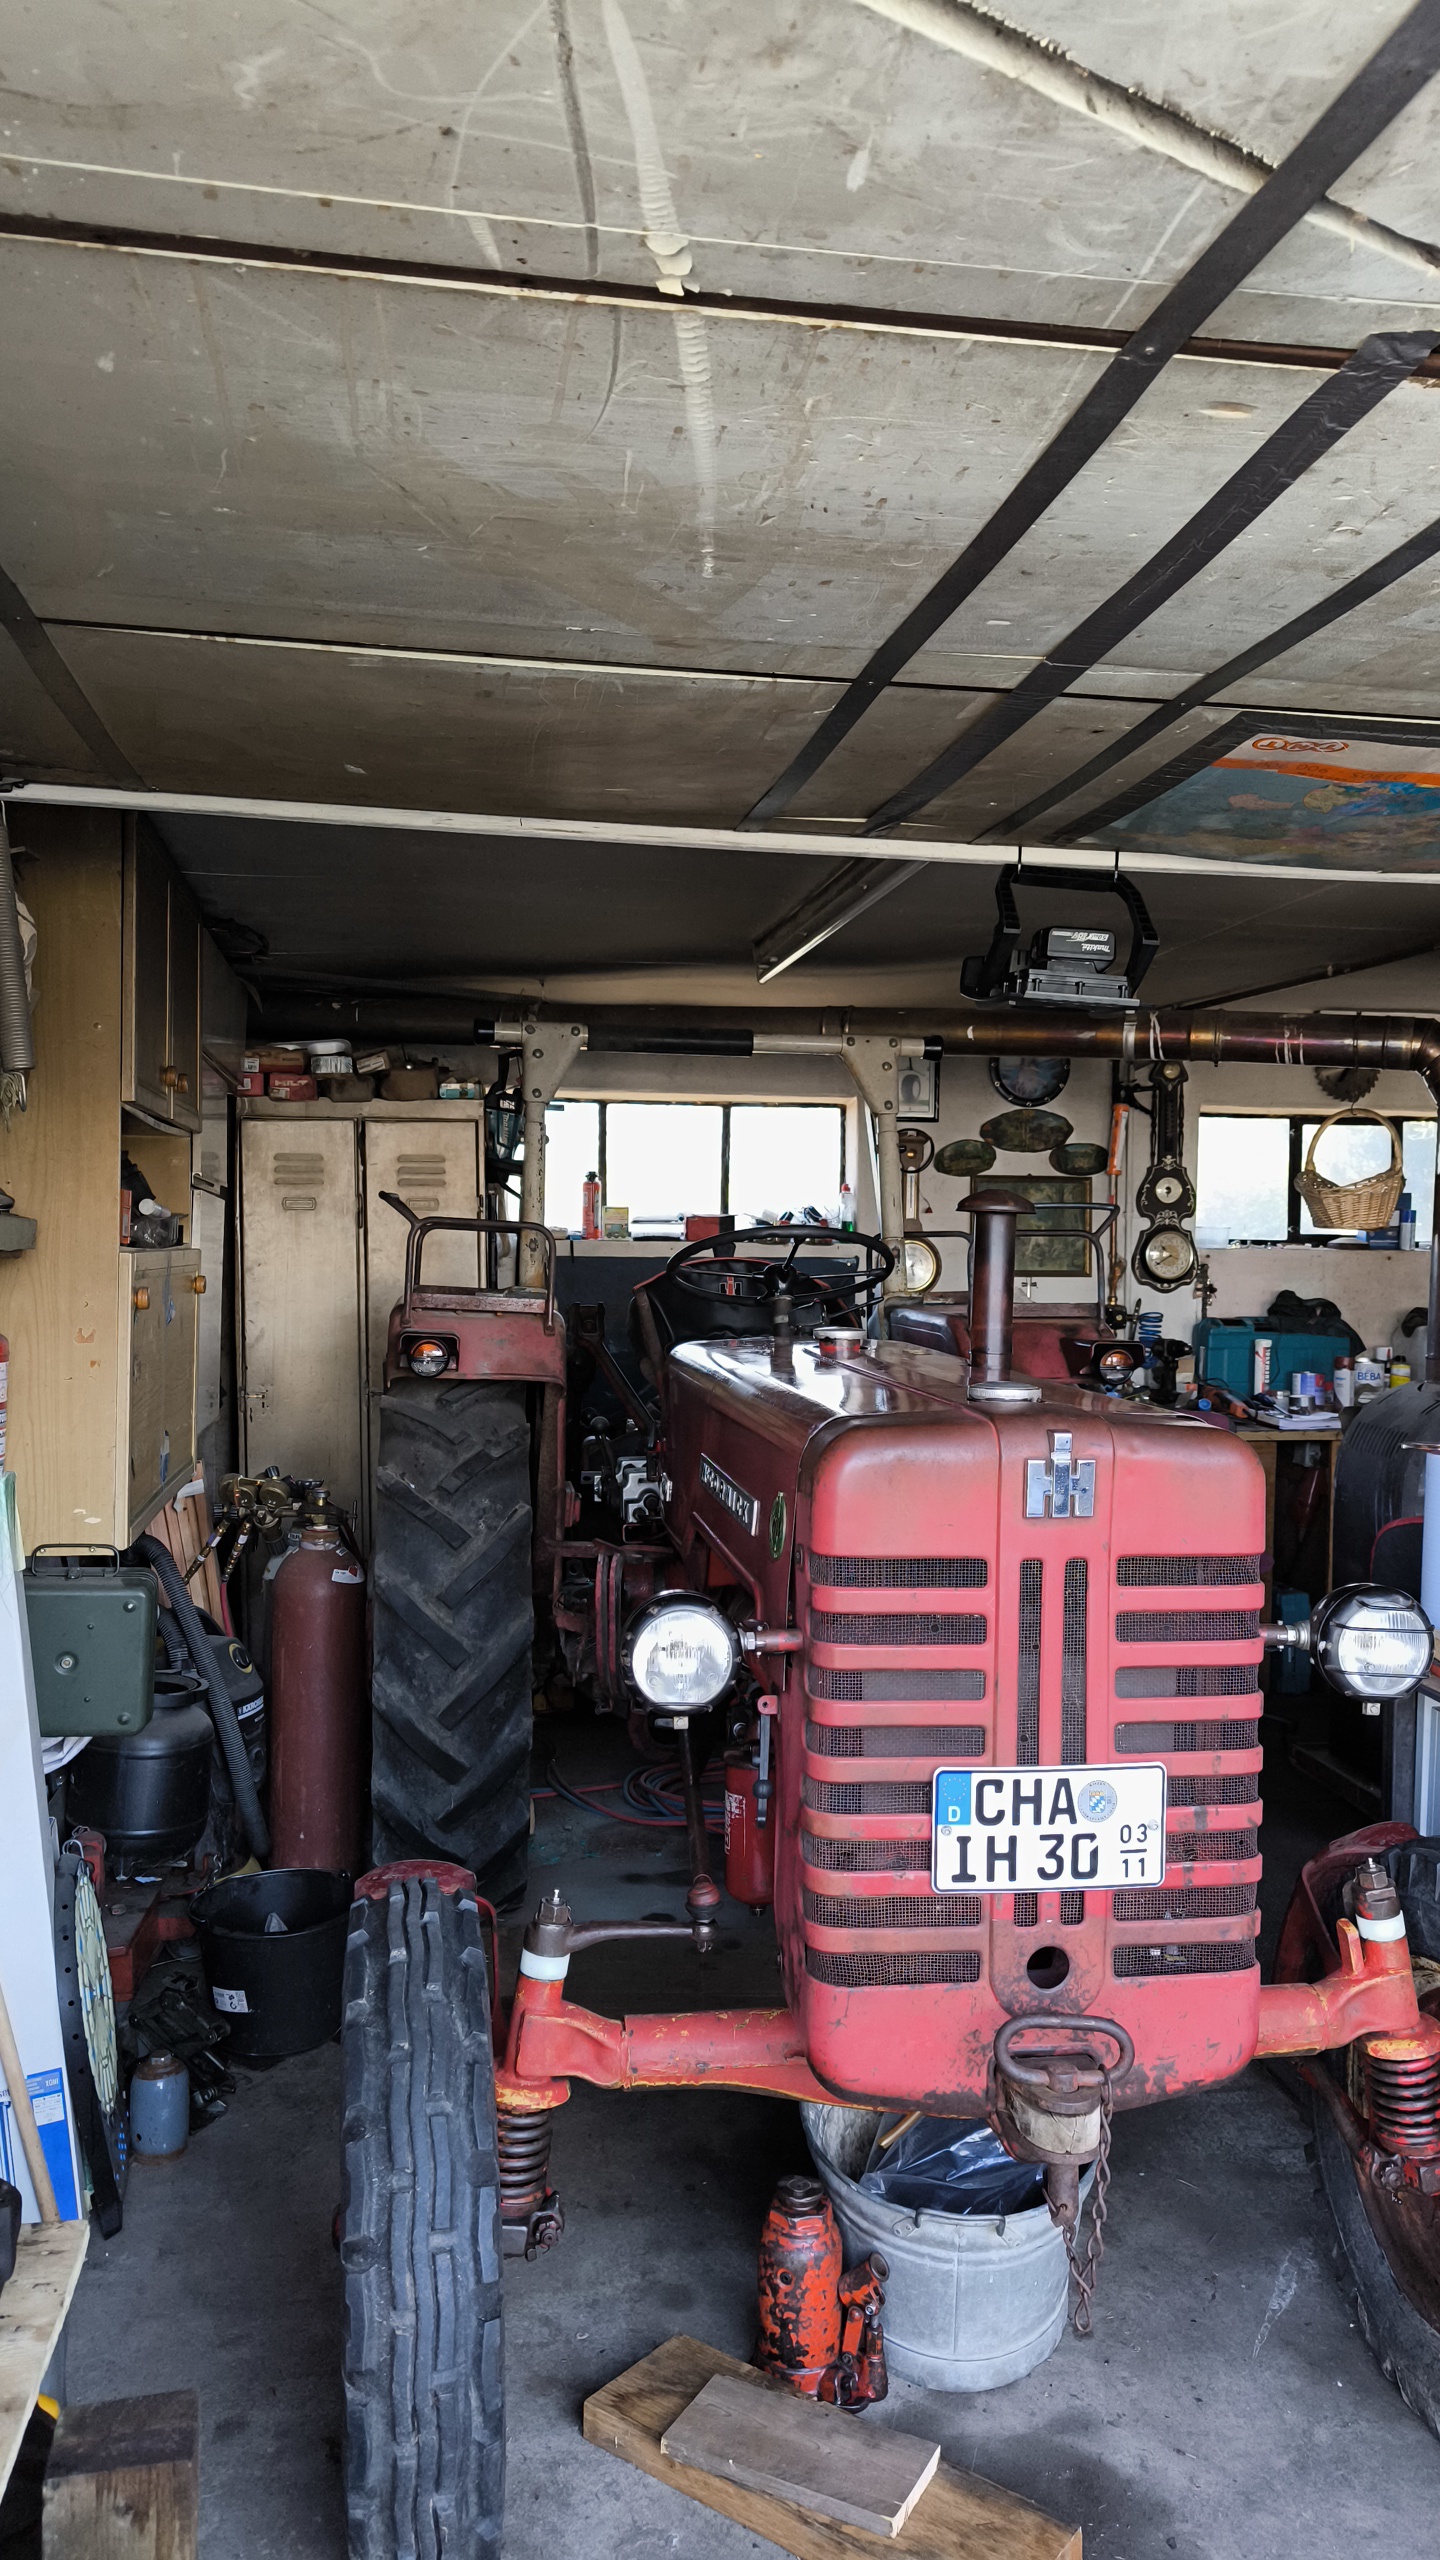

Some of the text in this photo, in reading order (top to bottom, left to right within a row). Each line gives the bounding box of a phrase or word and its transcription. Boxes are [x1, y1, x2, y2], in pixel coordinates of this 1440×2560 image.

[1254, 739, 1347, 753] TNT
[1081, 943, 1111, 953] makita
[499, 1113, 510, 1146] makita
[1357, 1371, 1381, 1381] BEBA
[975, 1778, 1078, 1826] CHA
[947, 1806, 961, 1823] D
[1120, 1823, 1148, 1844] 03
[951, 1832, 1099, 1883] IH 30
[1121, 1857, 1146, 1878] 11
[45, 2077, 60, 2088] INOX
